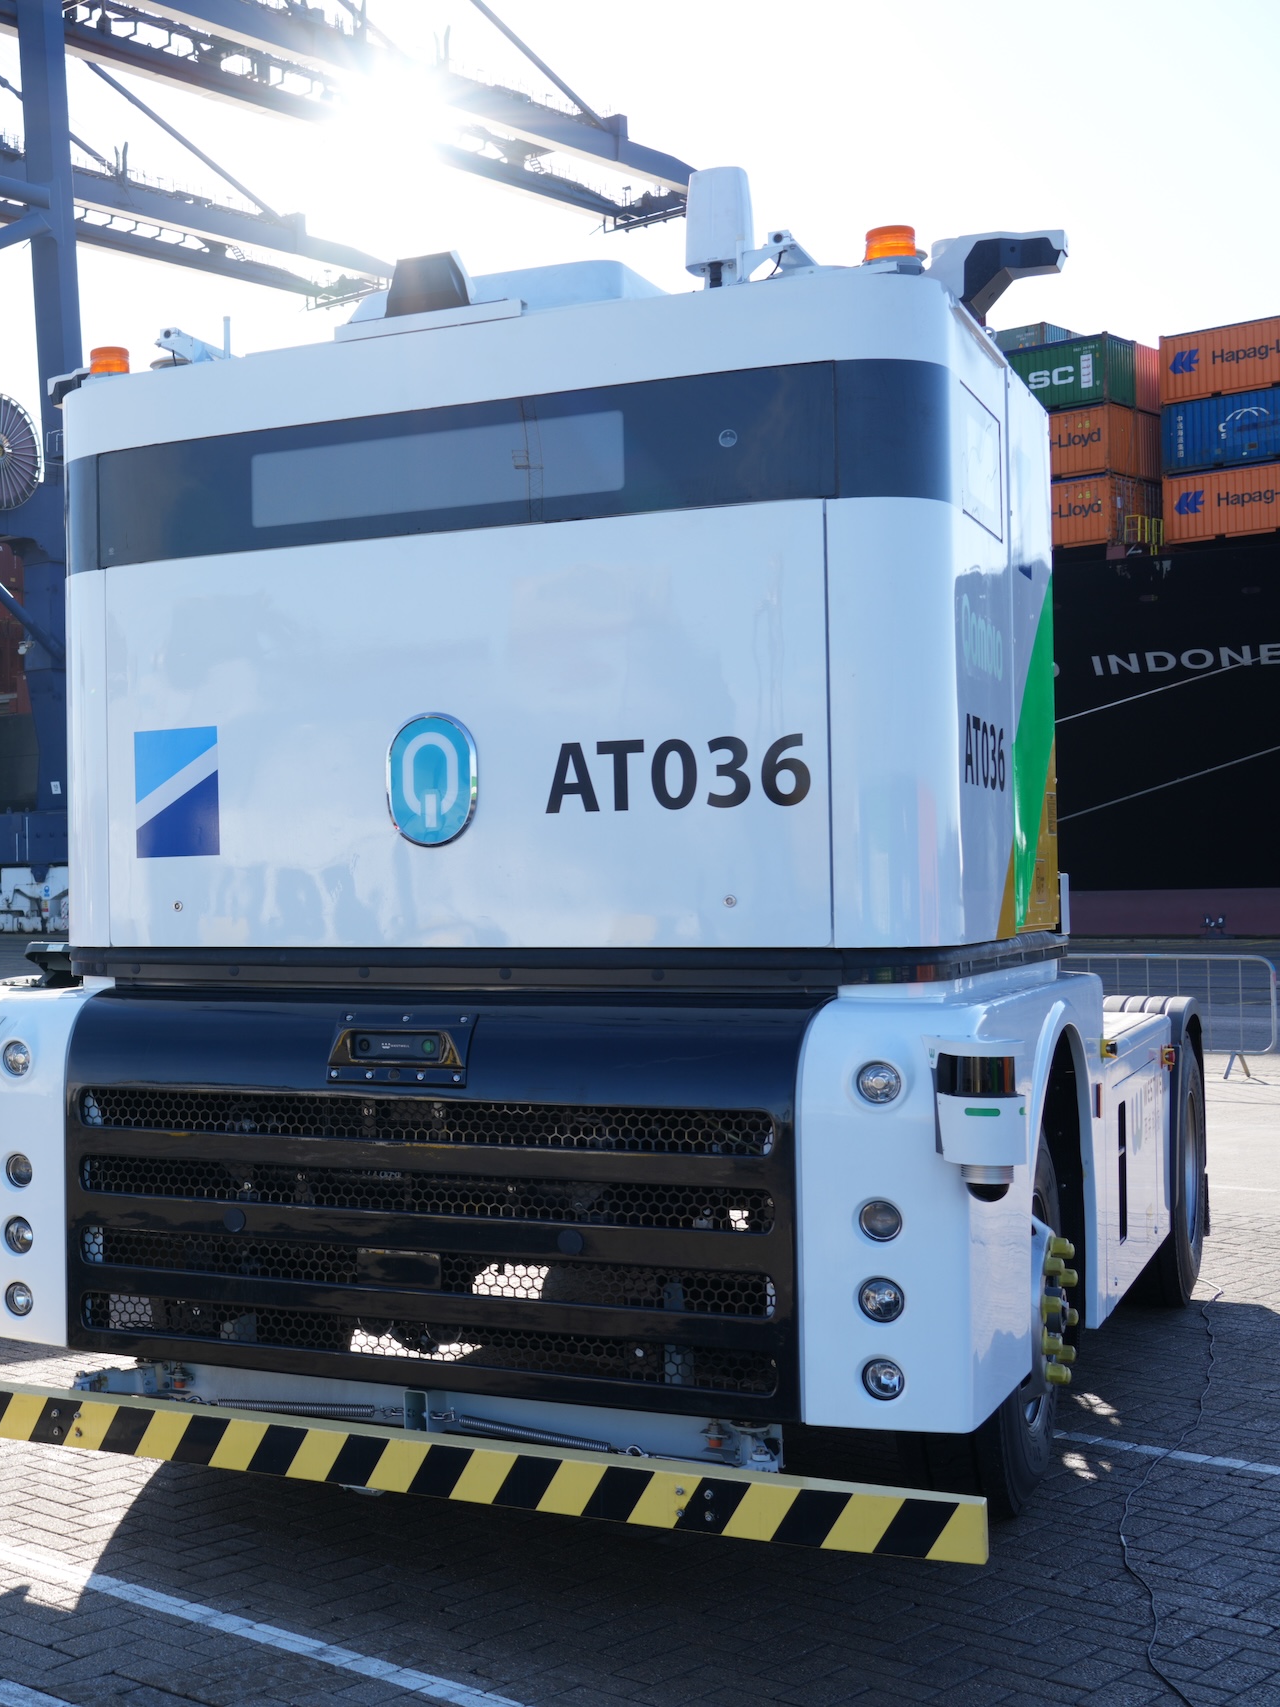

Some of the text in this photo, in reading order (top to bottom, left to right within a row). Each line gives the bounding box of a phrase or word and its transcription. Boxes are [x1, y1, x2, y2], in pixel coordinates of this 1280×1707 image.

[1050, 427, 1101, 450] -Lloyd
[545, 733, 811, 814] AT036
[965, 713, 1006, 792] AT036
